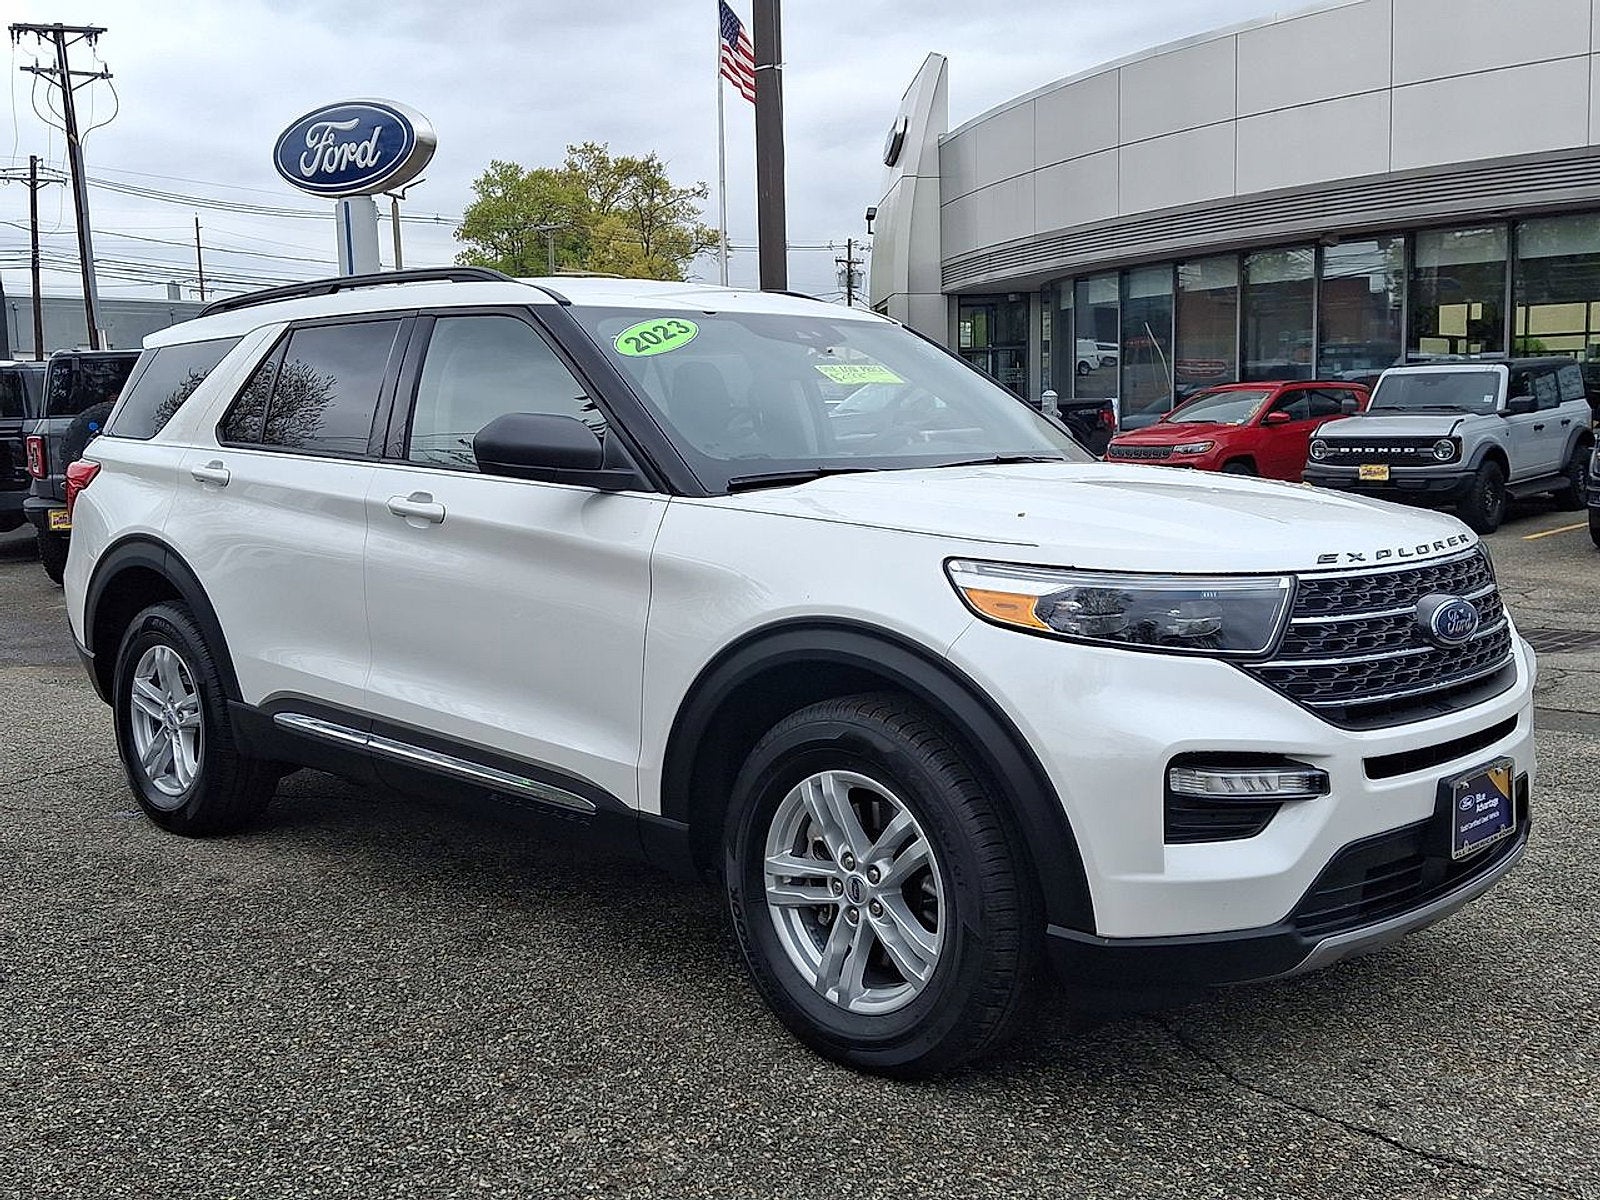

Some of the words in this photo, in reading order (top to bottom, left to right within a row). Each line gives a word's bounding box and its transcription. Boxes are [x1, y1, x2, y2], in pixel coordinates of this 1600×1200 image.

[300, 118, 382, 177] Ford
[625, 321, 689, 352] 2023
[1317, 533, 1470, 564] EXPLORER
[1447, 607, 1473, 635] Ford
